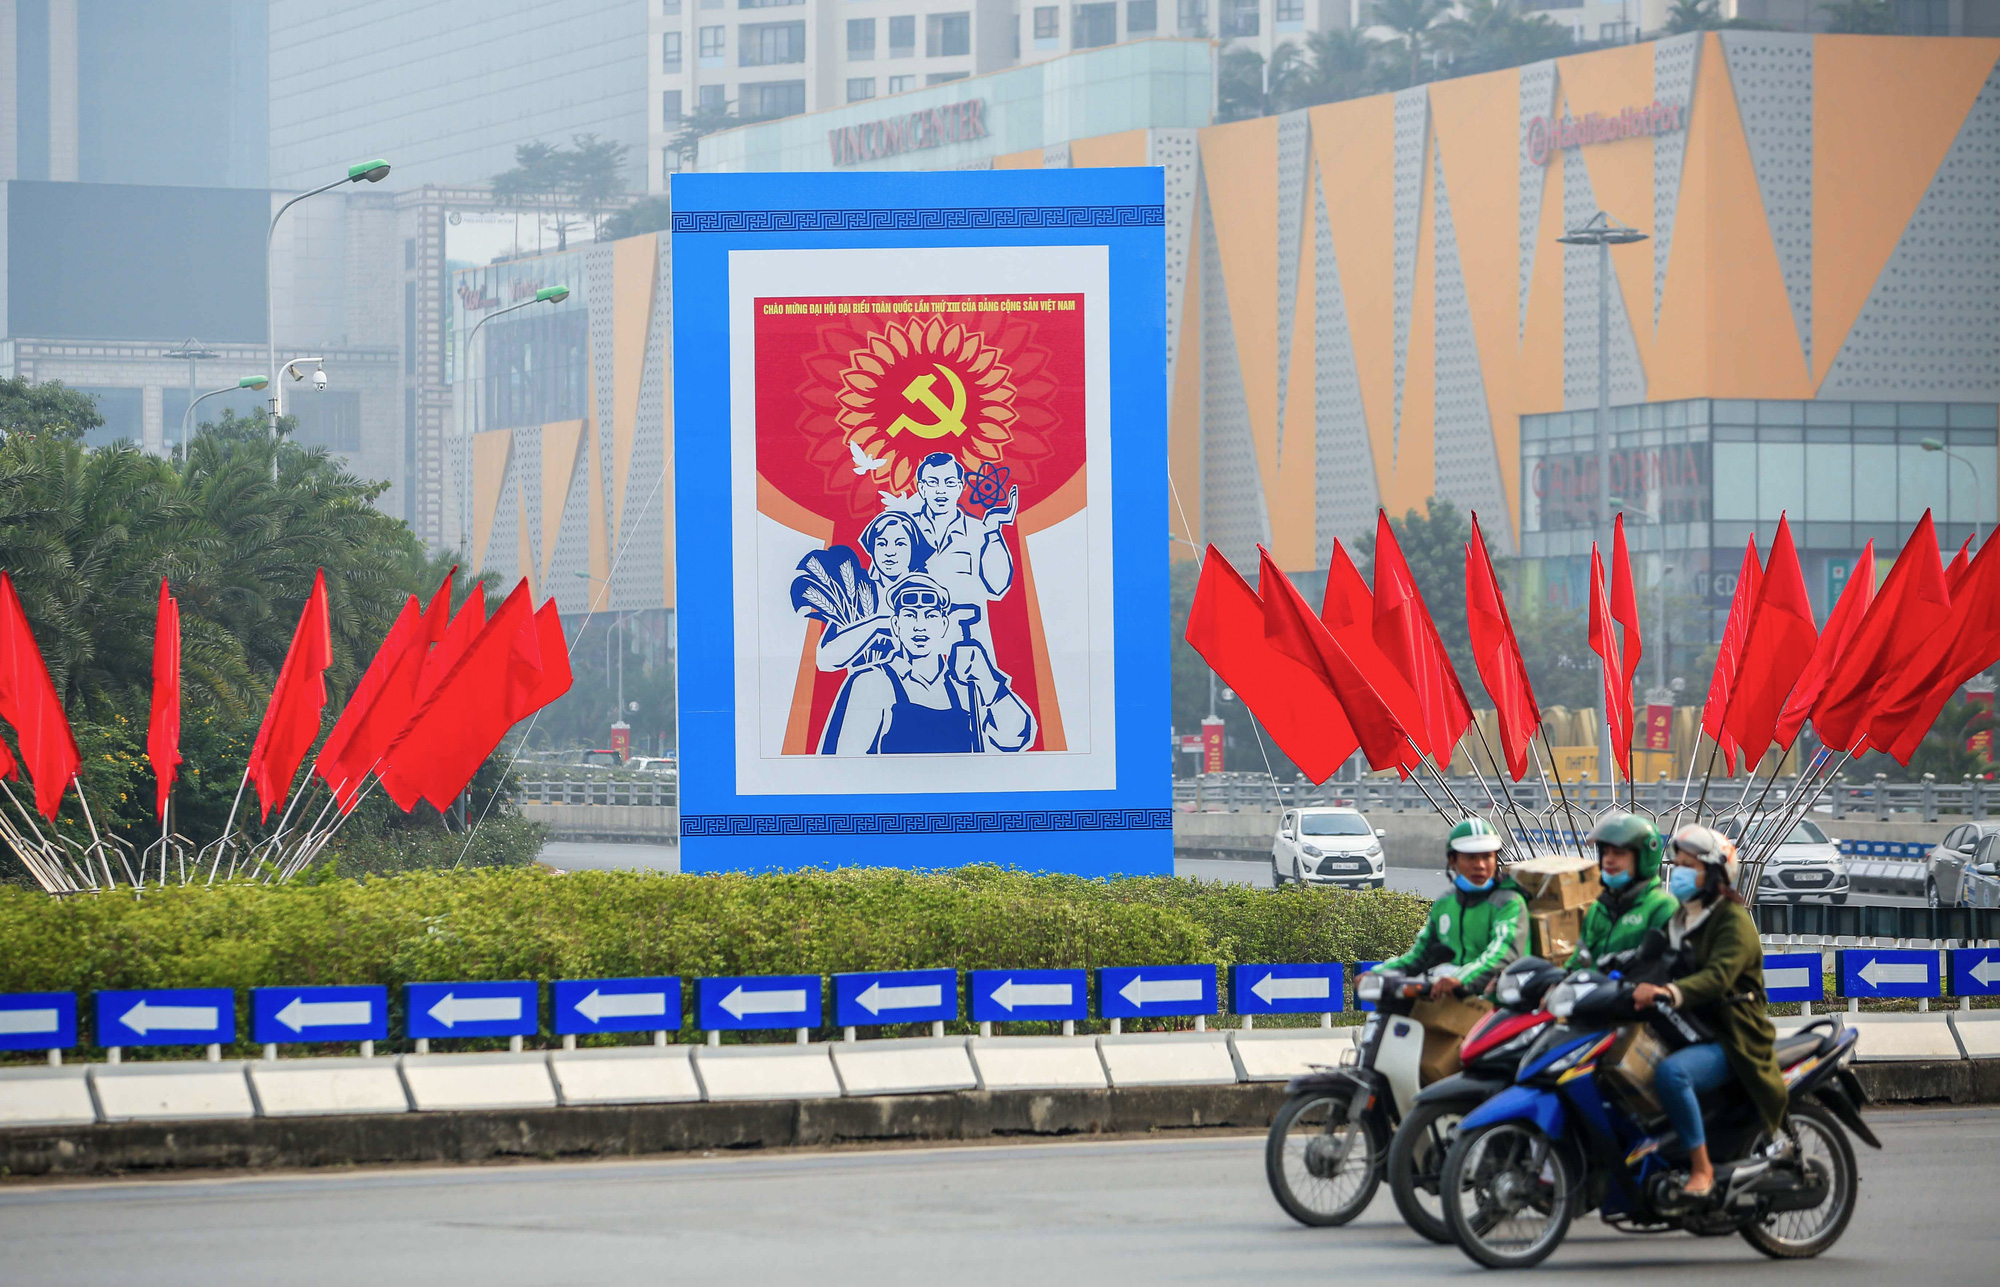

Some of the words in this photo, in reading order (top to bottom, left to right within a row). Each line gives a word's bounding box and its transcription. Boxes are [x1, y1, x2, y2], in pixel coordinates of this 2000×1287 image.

[828, 117, 906, 165] VINCOM
[904, 98, 986, 150] CENTER
[763, 302, 784, 315] CHÀO
[785, 301, 808, 314] MỪNG
[809, 303, 823, 316] ĐẠI
[824, 301, 837, 316] HỘI
[838, 303, 851, 316] ĐẠI
[853, 299, 870, 313] BIỂU
[871, 301, 891, 313] TOÀN
[892, 299, 913, 313] QUỐC
[931, 299, 946, 312] THỨ
[946, 301, 961, 312] XIII
[961, 297, 976, 312] CỦA
[978, 297, 999, 312] ĐẢNG
[1000, 299, 1021, 314] CỘNG
[1022, 296, 1039, 311] SẢN
[1040, 298, 1056, 313] VIỆT
[1057, 300, 1076, 311] NAM
